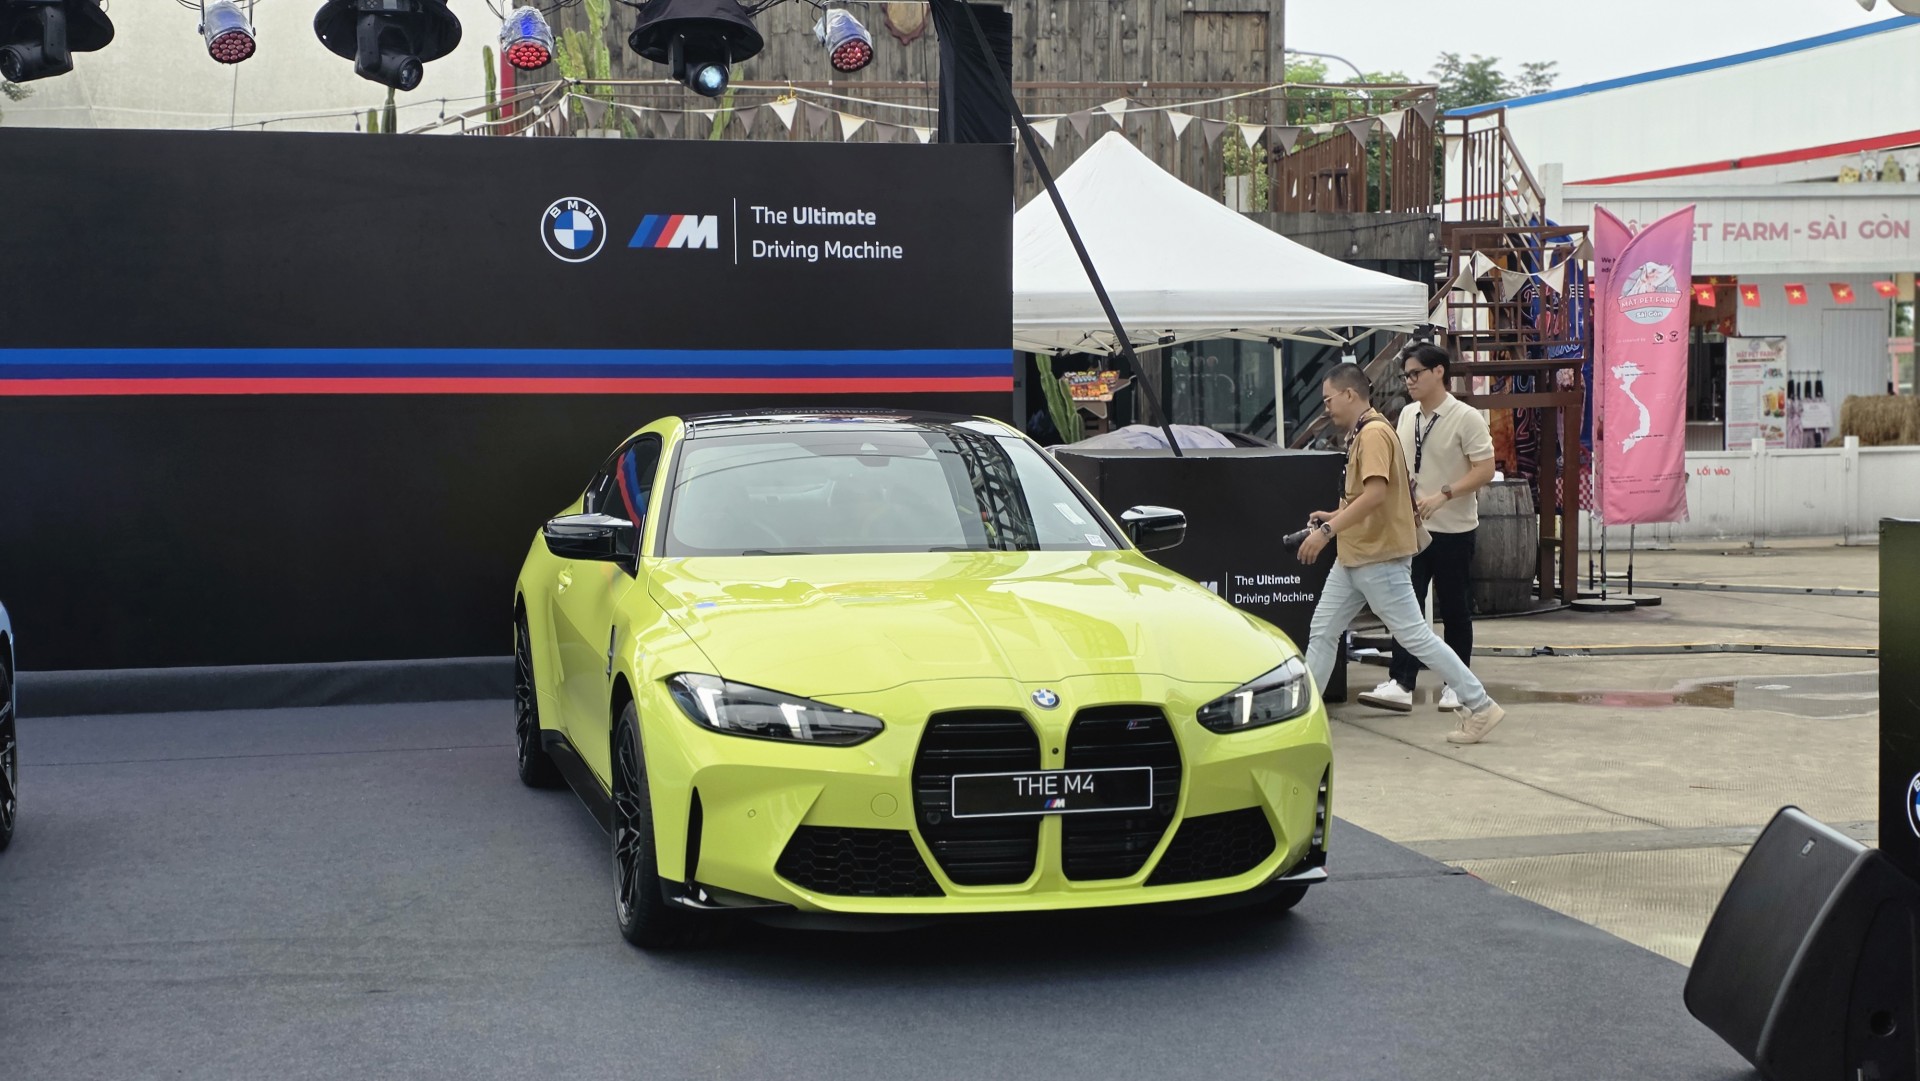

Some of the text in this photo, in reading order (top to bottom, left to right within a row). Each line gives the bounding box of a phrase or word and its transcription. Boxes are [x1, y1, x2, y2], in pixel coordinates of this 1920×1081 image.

[550, 201, 597, 219] BMW
[751, 206, 876, 226] The Ultimate
[666, 214, 718, 248] M
[1722, 222, 1789, 242] FARM
[1807, 214, 1847, 240] SÀI
[1858, 213, 1911, 240] GÒN
[752, 240, 903, 262] Driving Machine
[1655, 296, 1676, 304] FARM
[1234, 574, 1301, 586] The Ultimate
[1234, 592, 1314, 605] Driving Machine
[1012, 773, 1094, 796] THE M4
